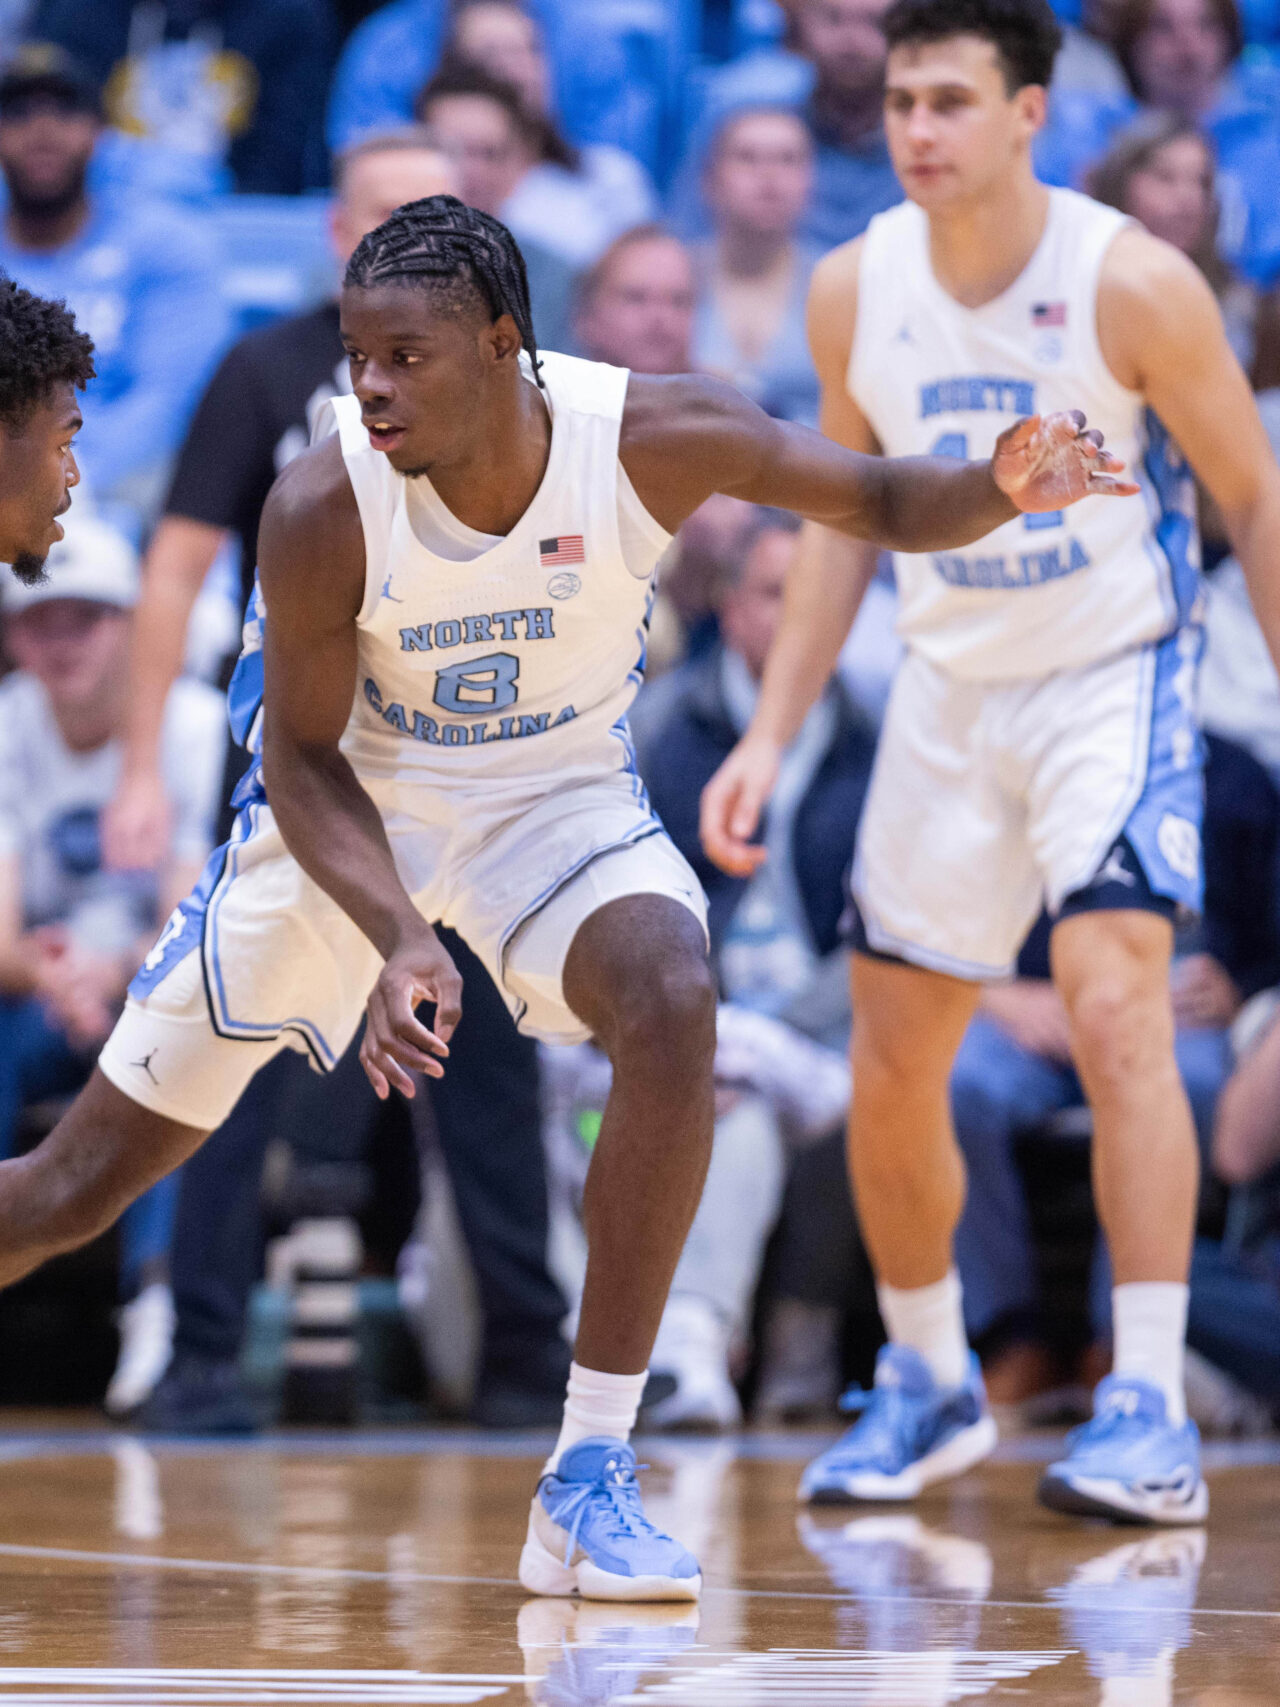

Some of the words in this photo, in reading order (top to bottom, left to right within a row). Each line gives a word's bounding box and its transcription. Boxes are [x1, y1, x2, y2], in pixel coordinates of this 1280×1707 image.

[920, 376, 1037, 419] NORTH
[931, 537, 1091, 589] AROLINA
[399, 608, 555, 651] NORTH
[433, 652, 520, 714] 8
[363, 678, 578, 747] CAROLINA
